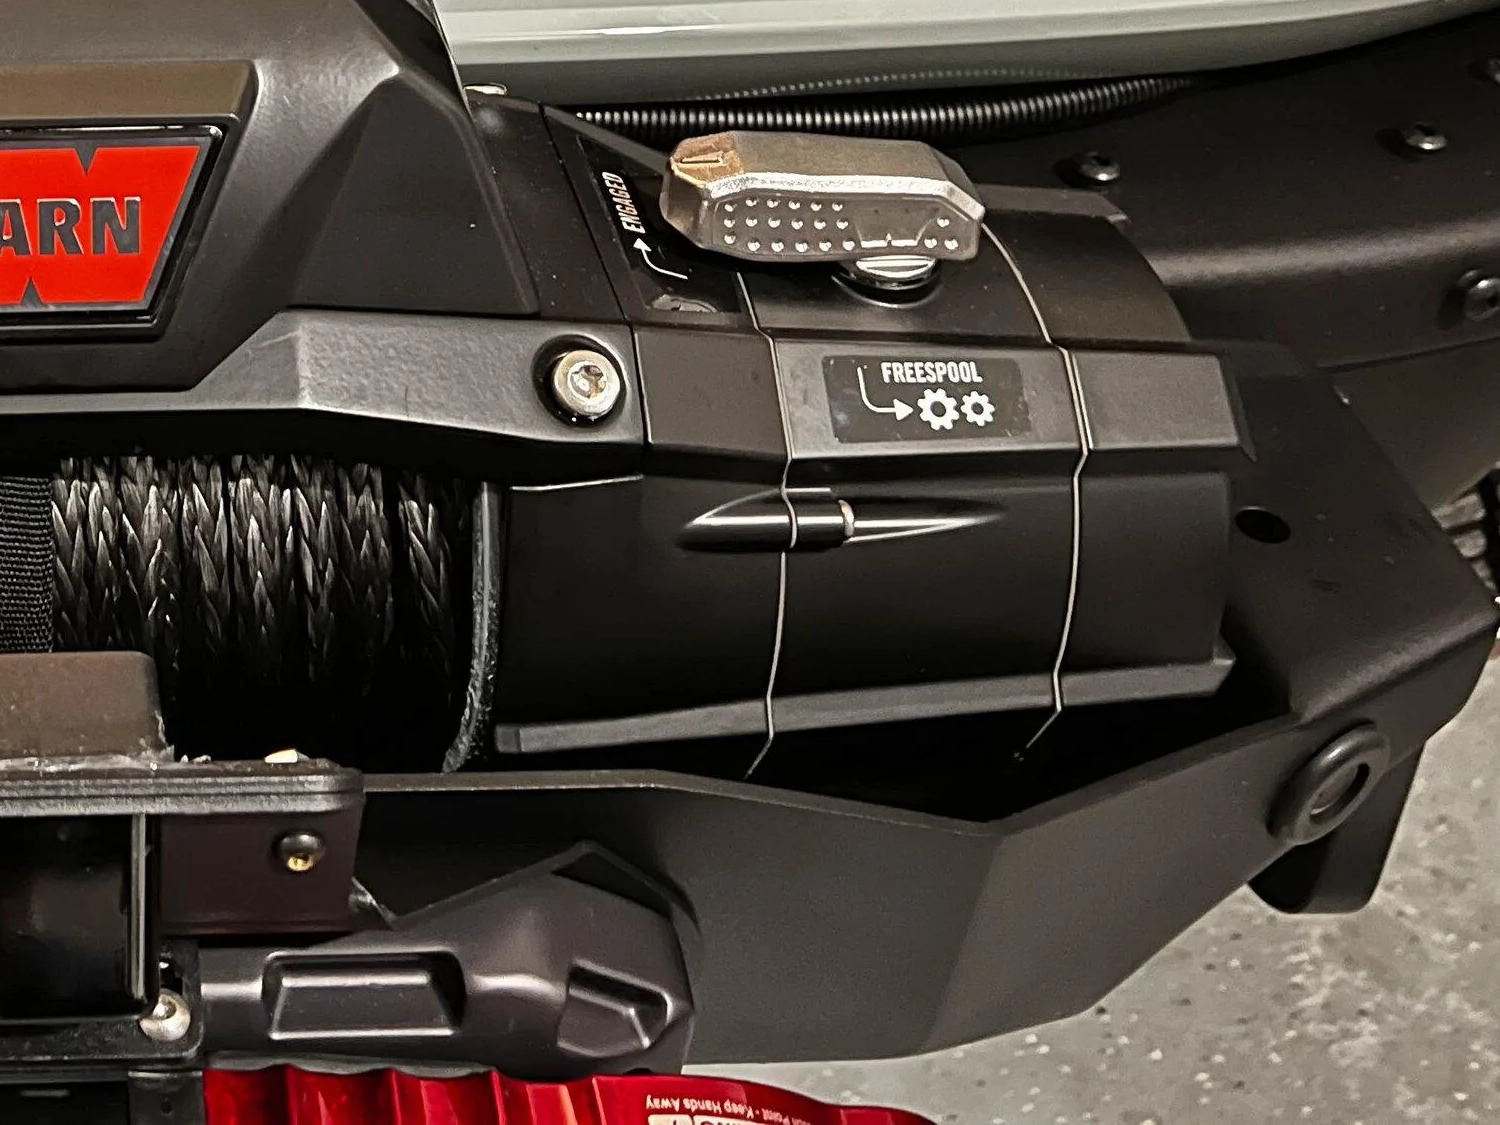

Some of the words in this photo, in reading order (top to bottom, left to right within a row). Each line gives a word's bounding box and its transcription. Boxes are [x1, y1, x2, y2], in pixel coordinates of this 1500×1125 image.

[602, 171, 646, 234] ENGAGED
[881, 361, 983, 383] FREESPOOL
[646, 1094, 680, 1112] Away
[683, 1098, 722, 1114] Hands
[724, 1099, 754, 1119] Keep
